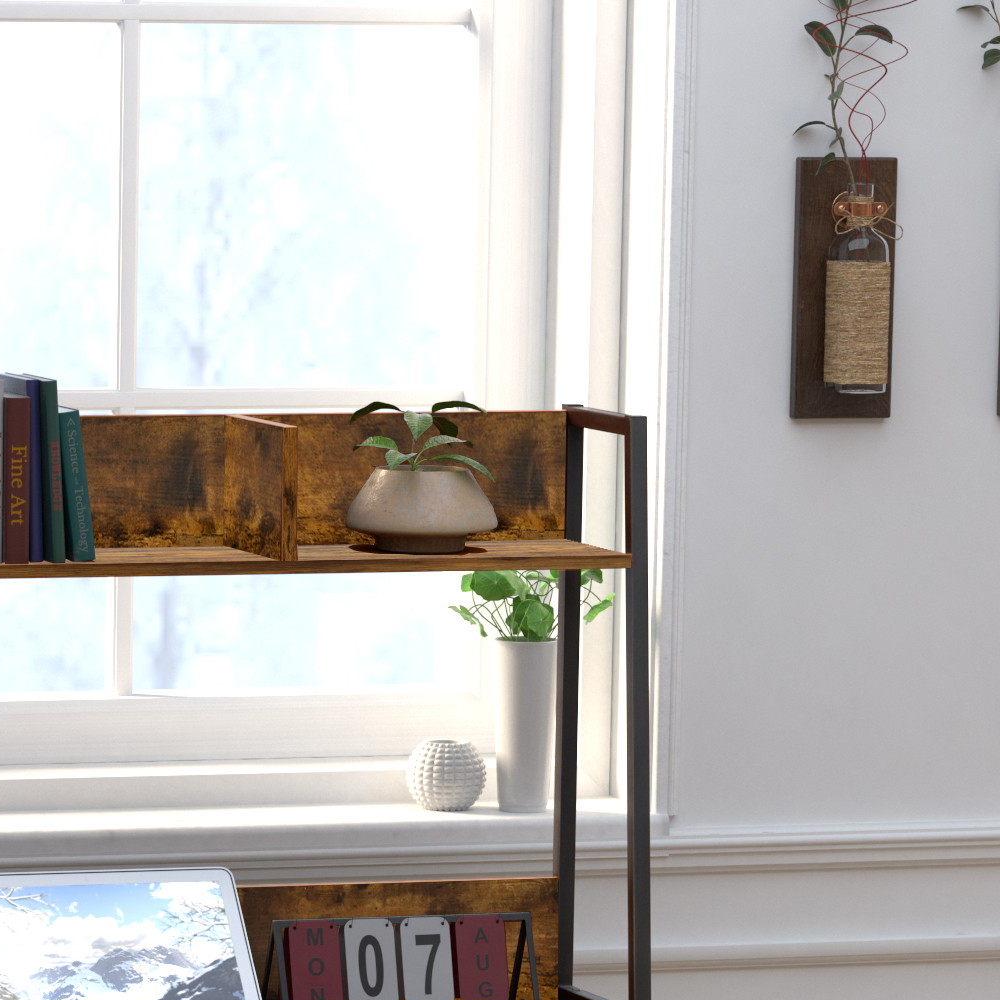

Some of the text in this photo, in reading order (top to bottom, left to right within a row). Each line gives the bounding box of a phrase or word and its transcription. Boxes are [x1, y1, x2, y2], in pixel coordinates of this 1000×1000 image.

[11, 445, 27, 526] Fine Art
[67, 429, 79, 475] Science
[73, 485, 89, 553] Technology
